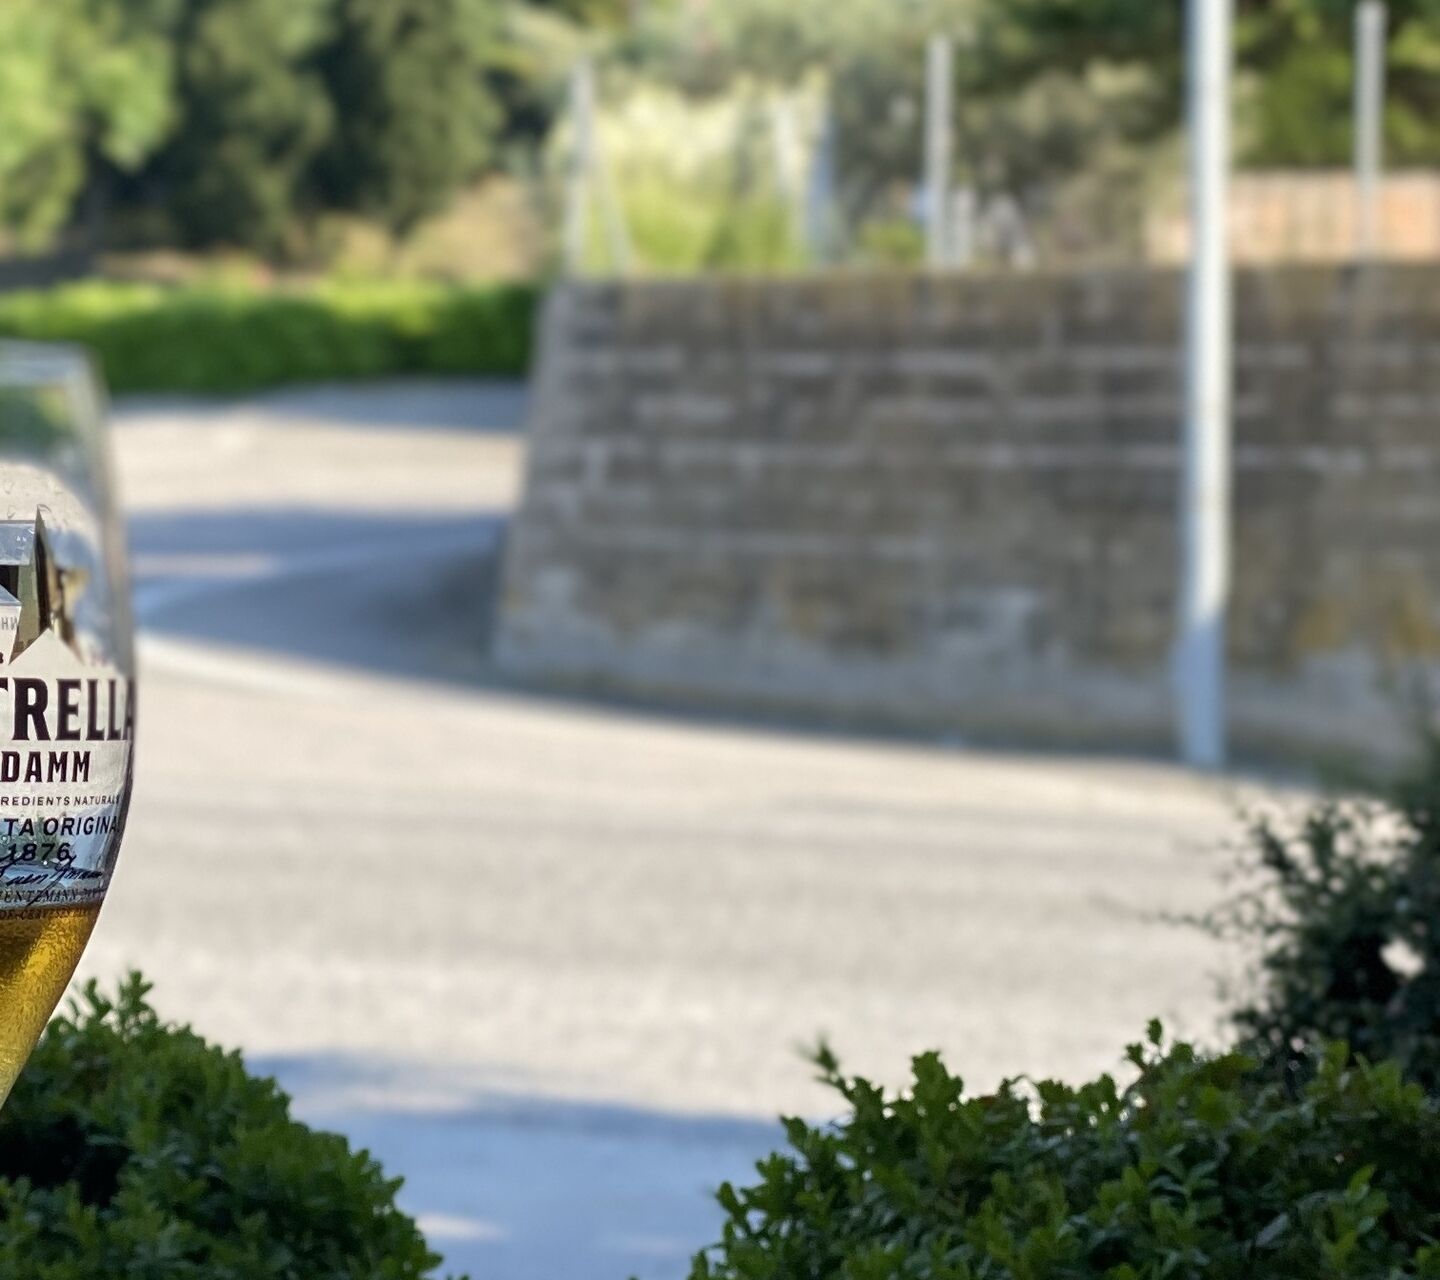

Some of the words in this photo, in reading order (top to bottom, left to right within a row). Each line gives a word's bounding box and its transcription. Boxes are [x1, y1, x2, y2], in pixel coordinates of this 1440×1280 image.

[0, 750, 92, 784] DAMM
[42, 815, 119, 836] ORIGINA
[7, 842, 71, 862] 1876
